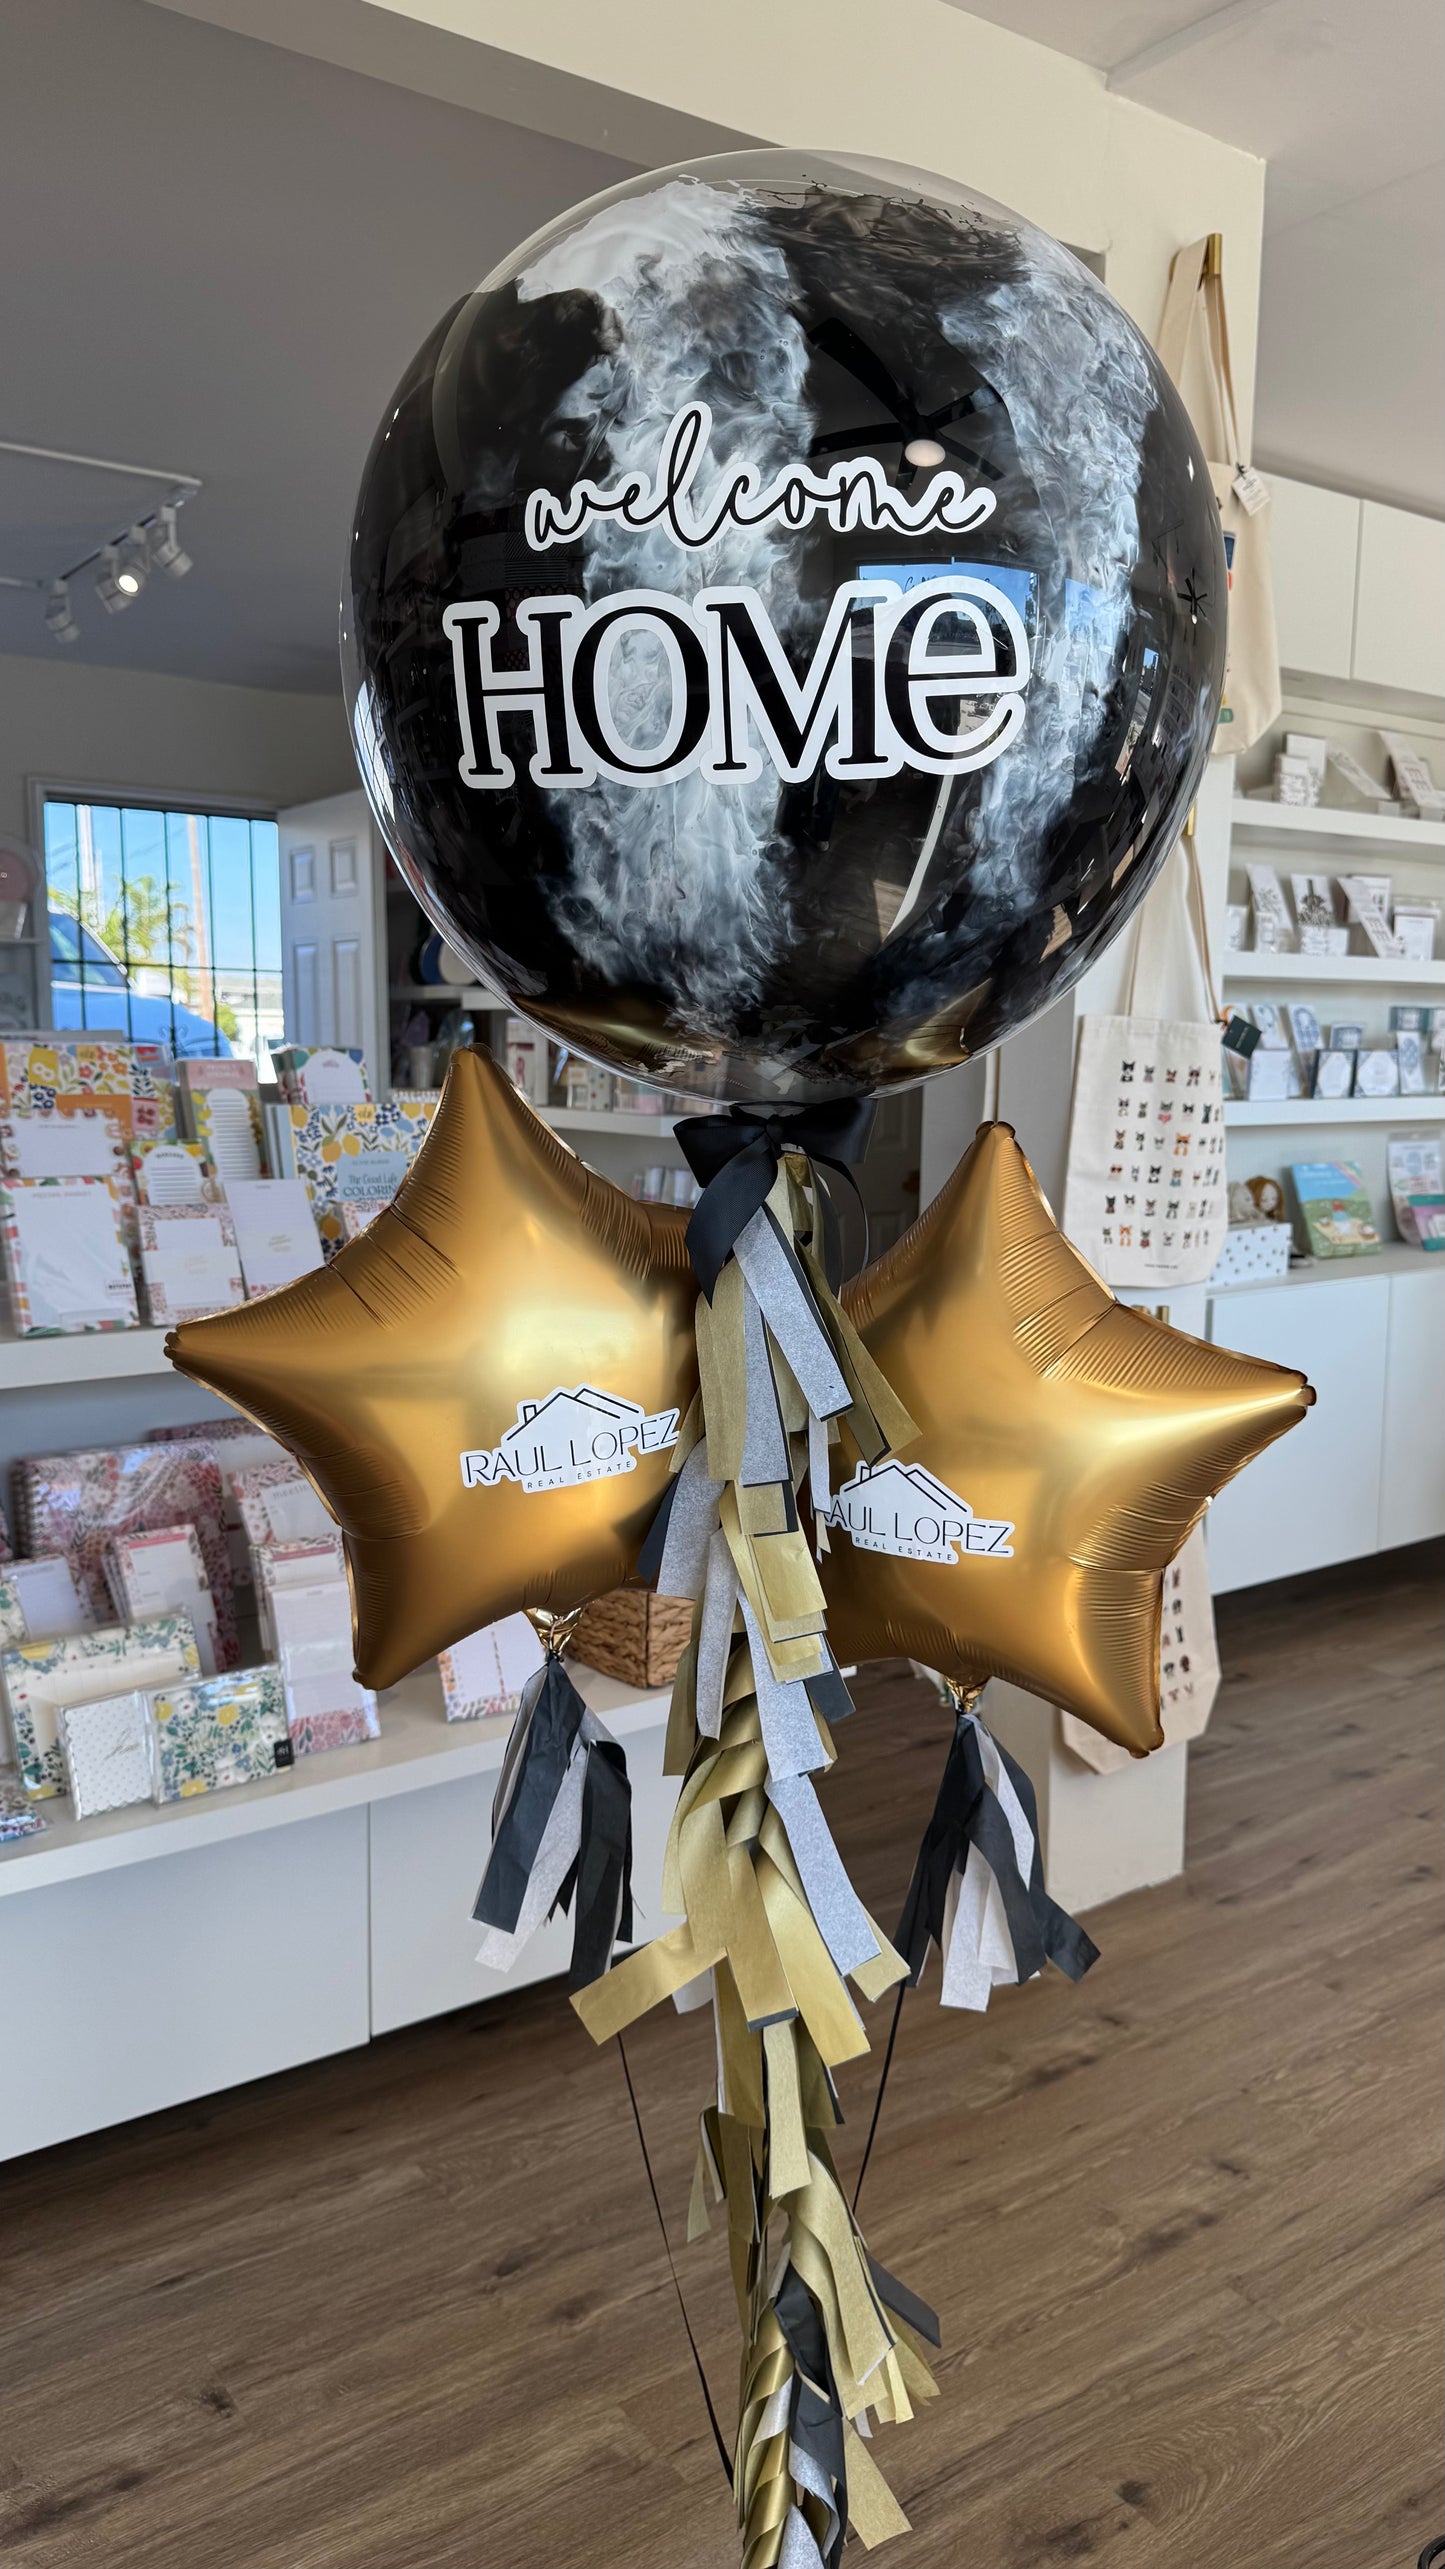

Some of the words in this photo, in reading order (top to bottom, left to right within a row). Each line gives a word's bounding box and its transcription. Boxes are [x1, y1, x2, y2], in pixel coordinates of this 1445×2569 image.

[531, 406, 992, 549] welcome
[343, 1184, 398, 1198] COLORIN
[465, 1445, 563, 1484] RAUL
[569, 1412, 679, 1467] LOPEZ
[526, 1476, 565, 1489] REAL
[576, 1460, 632, 1481] ESTATE
[855, 1536, 888, 1550] REAL
[898, 1545, 953, 1561] ESTATE
[894, 1511, 1011, 1555] LOPEZ
